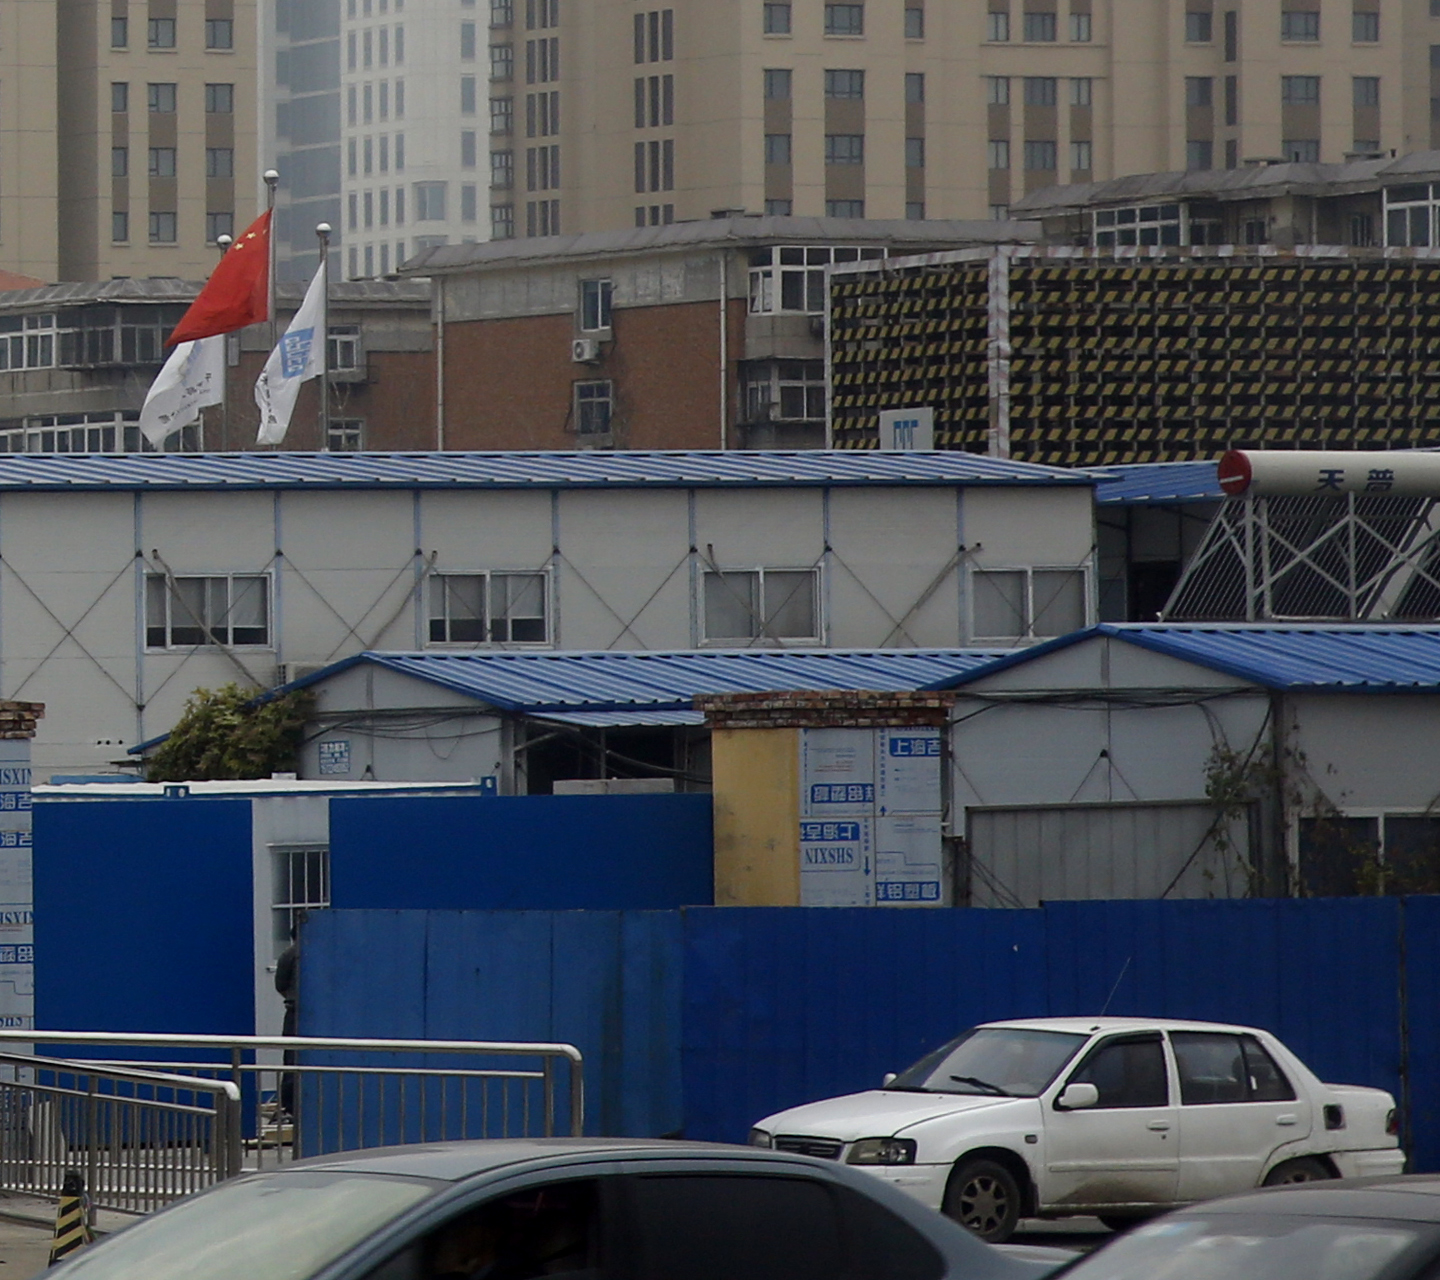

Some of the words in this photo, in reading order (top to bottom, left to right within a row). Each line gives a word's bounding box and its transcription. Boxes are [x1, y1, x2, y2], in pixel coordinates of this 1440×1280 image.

[1314, 468, 1395, 492] 天普
[800, 823, 856, 840] 上海吉
